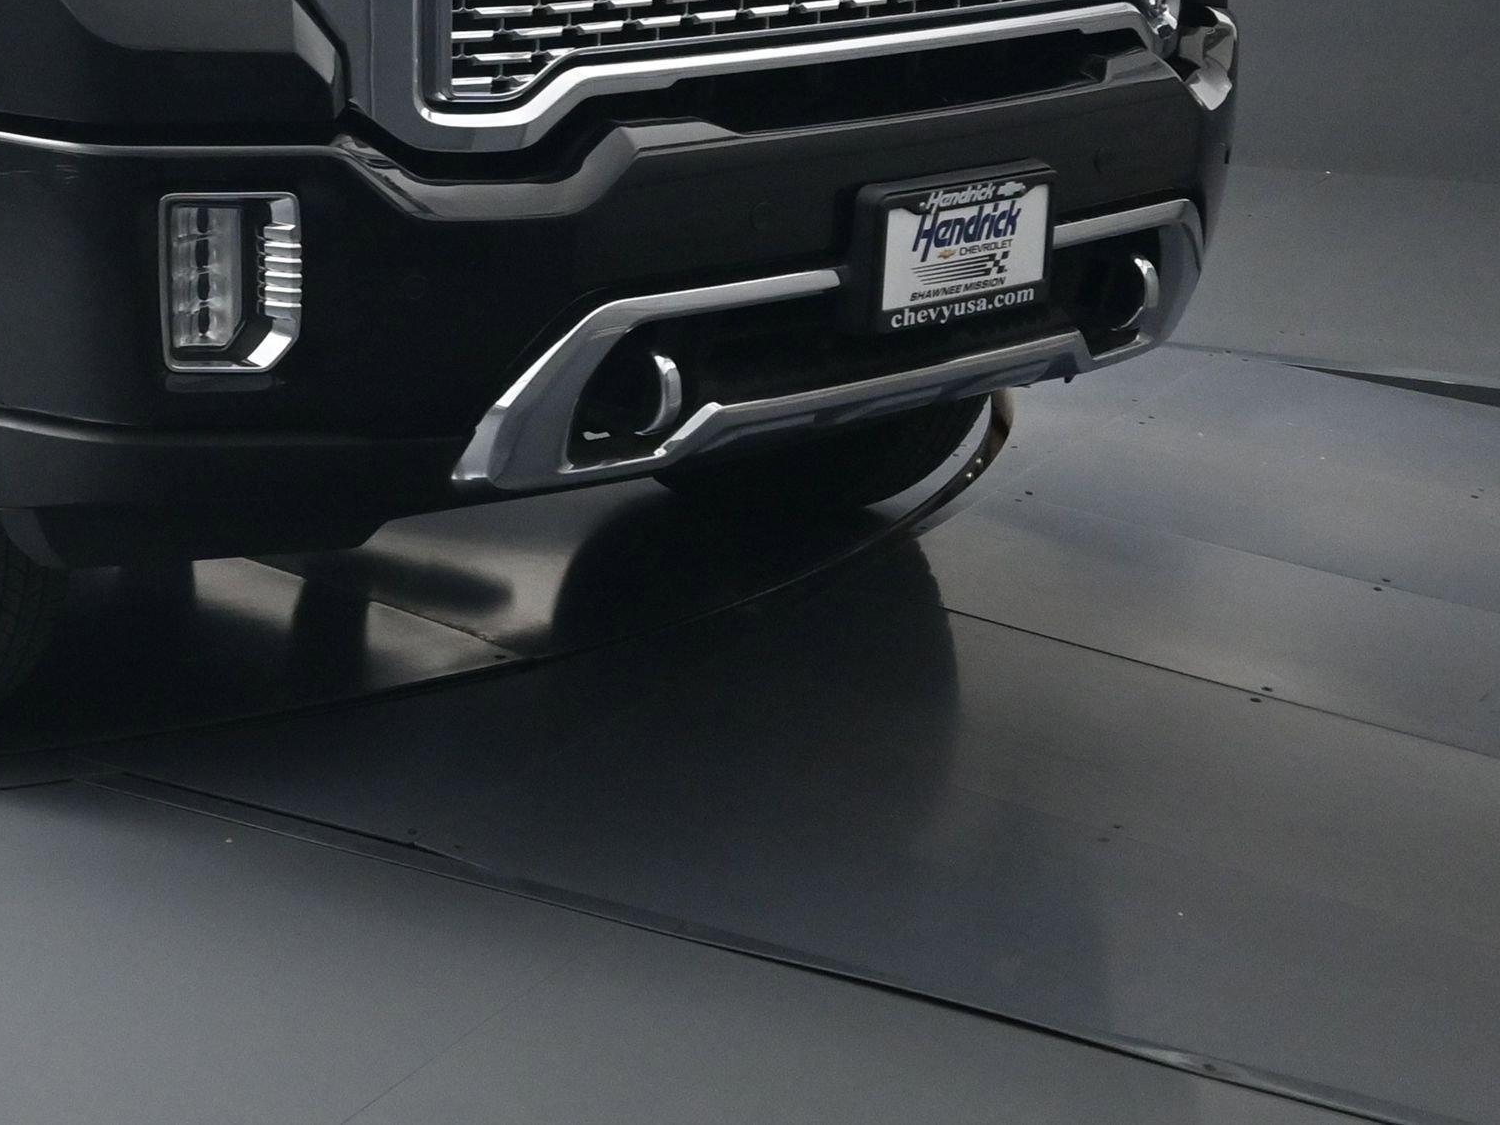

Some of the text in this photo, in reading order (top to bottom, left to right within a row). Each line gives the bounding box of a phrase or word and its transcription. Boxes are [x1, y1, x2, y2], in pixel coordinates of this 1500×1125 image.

[926, 182, 995, 211] Hendrick
[911, 200, 1022, 263] Hendrick
[958, 238, 1014, 257] CHEVROLET
[909, 277, 1007, 302] SHAWNEE MISSION
[890, 287, 1035, 329] chevyusa.com
